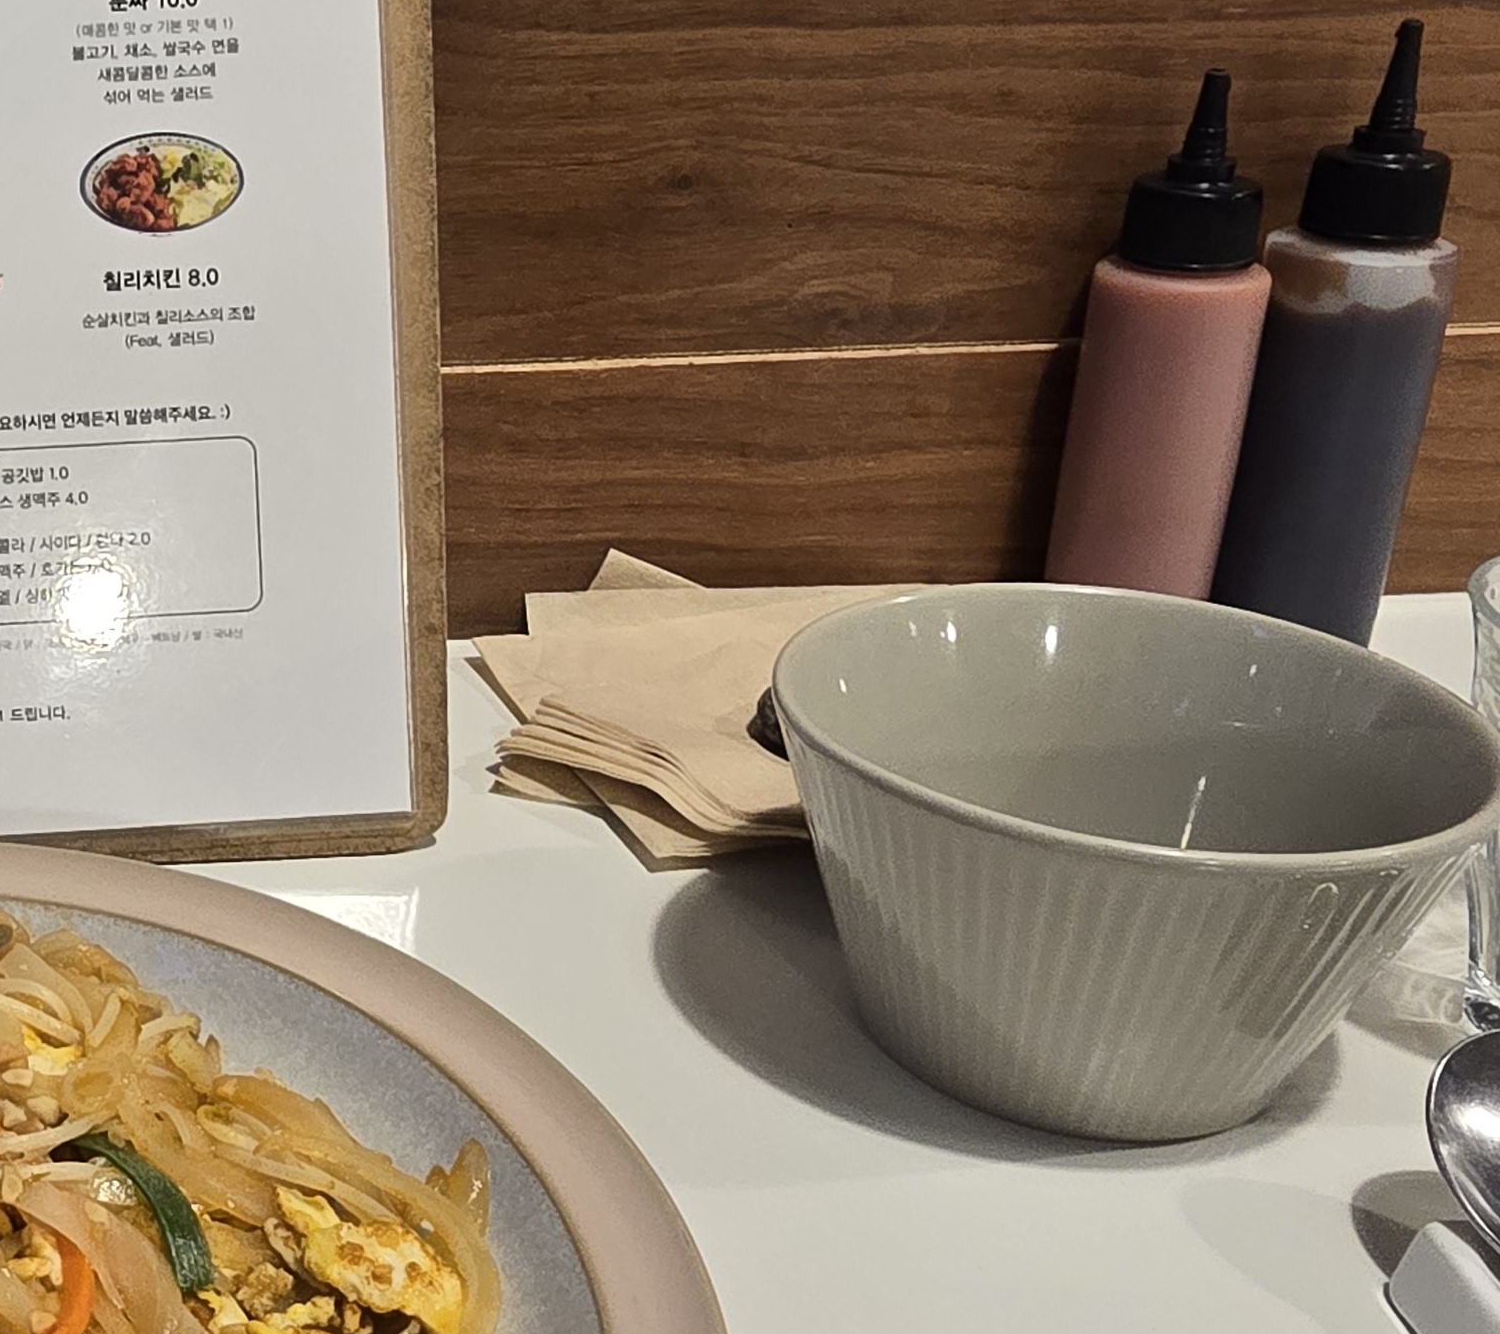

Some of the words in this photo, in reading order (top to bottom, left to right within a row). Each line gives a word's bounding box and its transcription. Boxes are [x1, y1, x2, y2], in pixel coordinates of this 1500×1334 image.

[123, 21, 136, 36] 맛
[139, 23, 152, 34] or
[157, 19, 182, 34] 기본
[186, 18, 199, 33] 맛
[162, 40, 205, 56] 쌀국수
[211, 37, 239, 54] 면을
[97, 64, 168, 82] 새콤달콤한
[173, 61, 216, 78] 소스에
[136, 87, 164, 103] 먹는
[170, 85, 213, 102] 샐러드
[102, 267, 180, 291] 칠리치킨
[188, 267, 218, 287] 8.0
[82, 311, 150, 328] 순살치킨과
[155, 306, 223, 324] 칠리소스의
[227, 305, 255, 320] 조합
[167, 329, 214, 347] 샐러드)
[60, 409, 119, 428] 언제든지
[1, 466, 44, 484] 공깃밥
[49, 465, 69, 480] 1.0
[17, 491, 60, 509] 생맥주
[65, 490, 88, 505] 4.0
[39, 533, 81, 551] 사이다
[40, 561, 84, 576] 호가
[9, 705, 70, 721] 드립니다.
